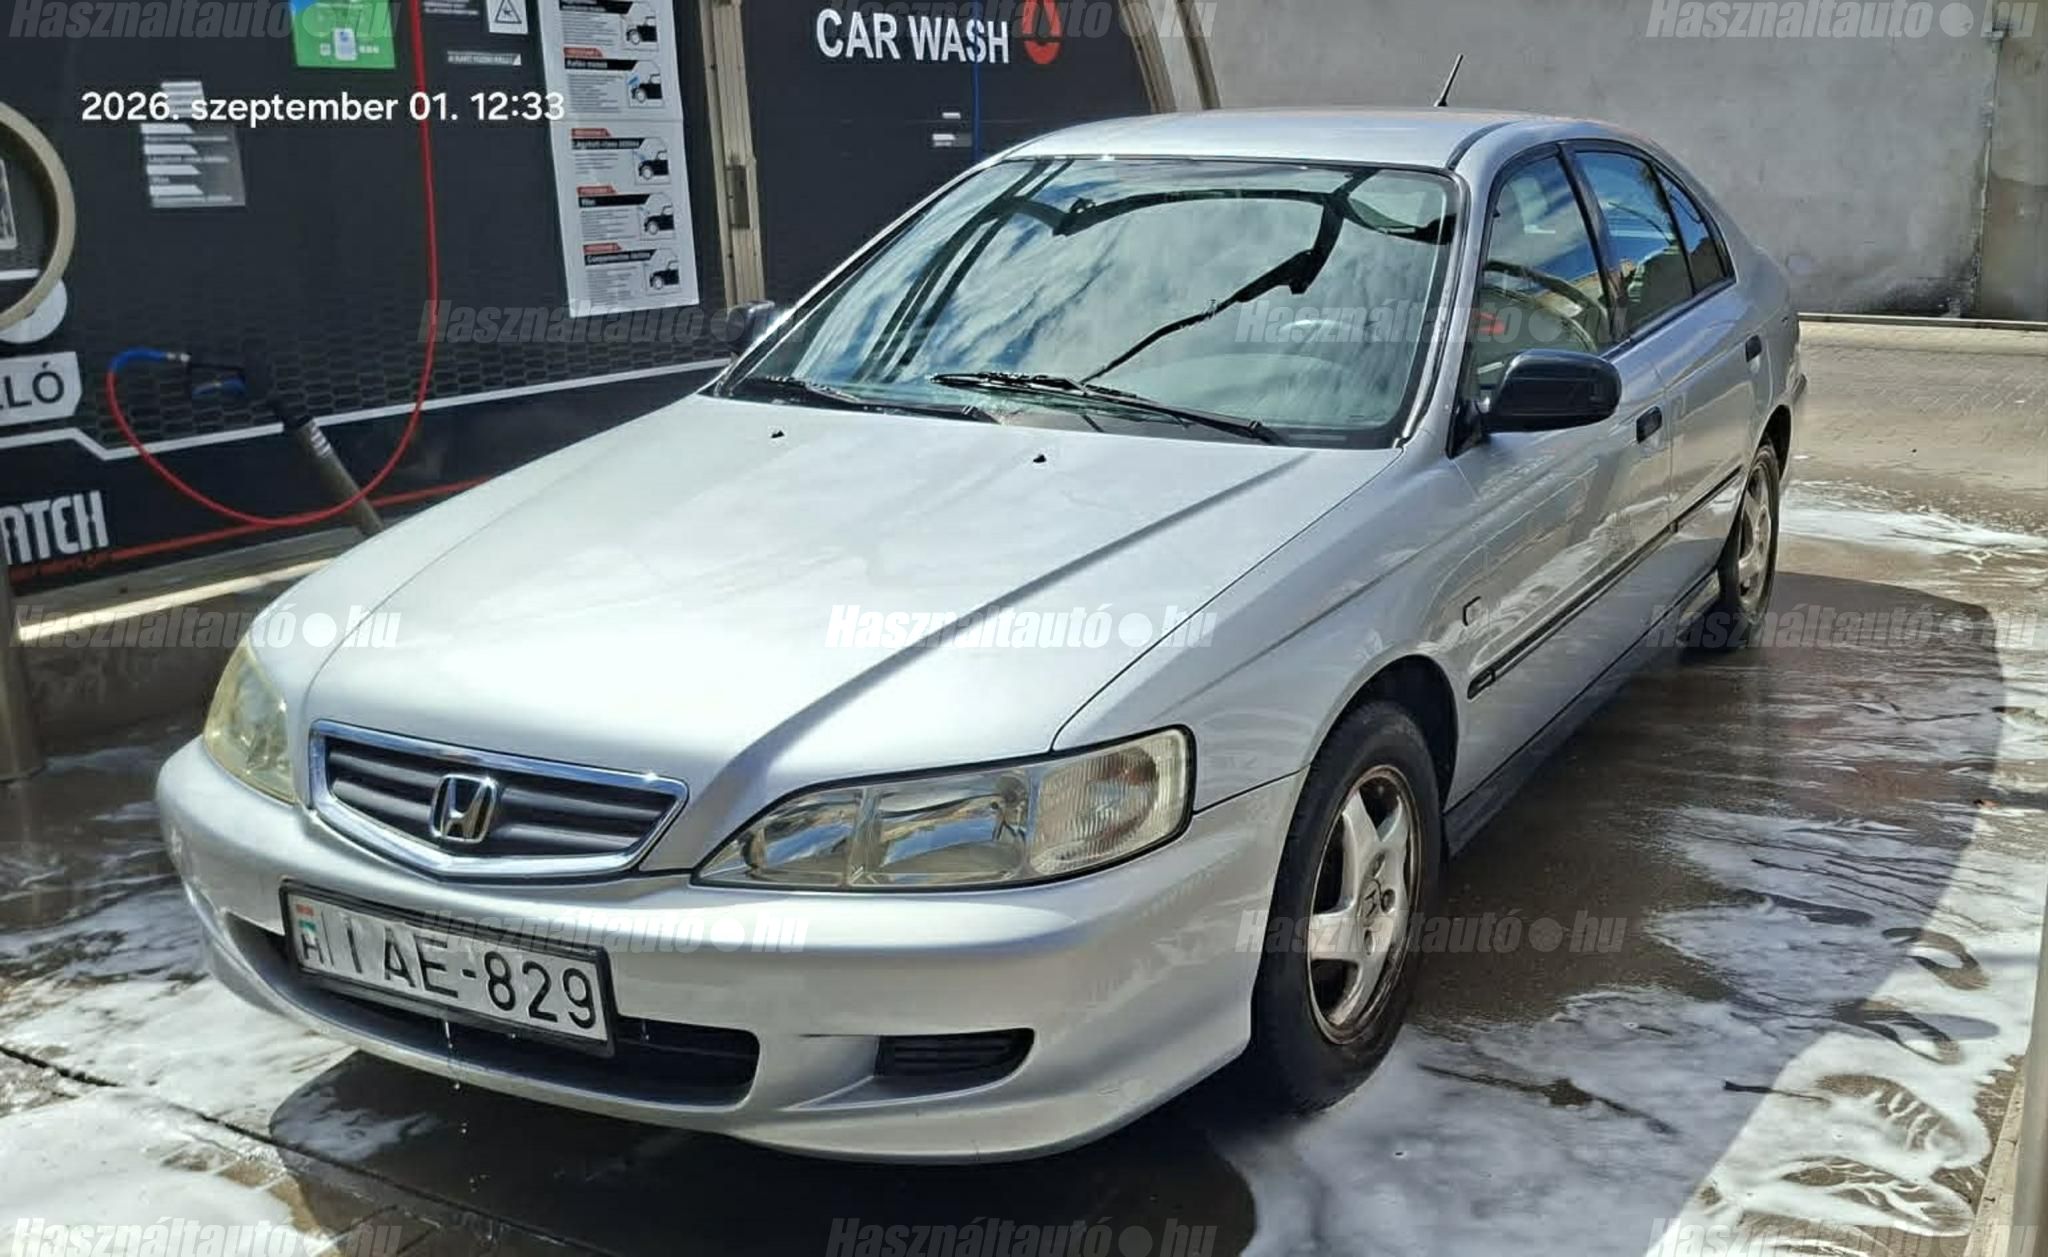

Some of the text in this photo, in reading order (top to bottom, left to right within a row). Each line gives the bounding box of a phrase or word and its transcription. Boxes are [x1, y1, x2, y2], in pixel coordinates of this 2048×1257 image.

[816, 9, 1010, 64] CAR WASH
[0, 362, 65, 412] LÓ
[346, 924, 597, 1030] IAE-829
